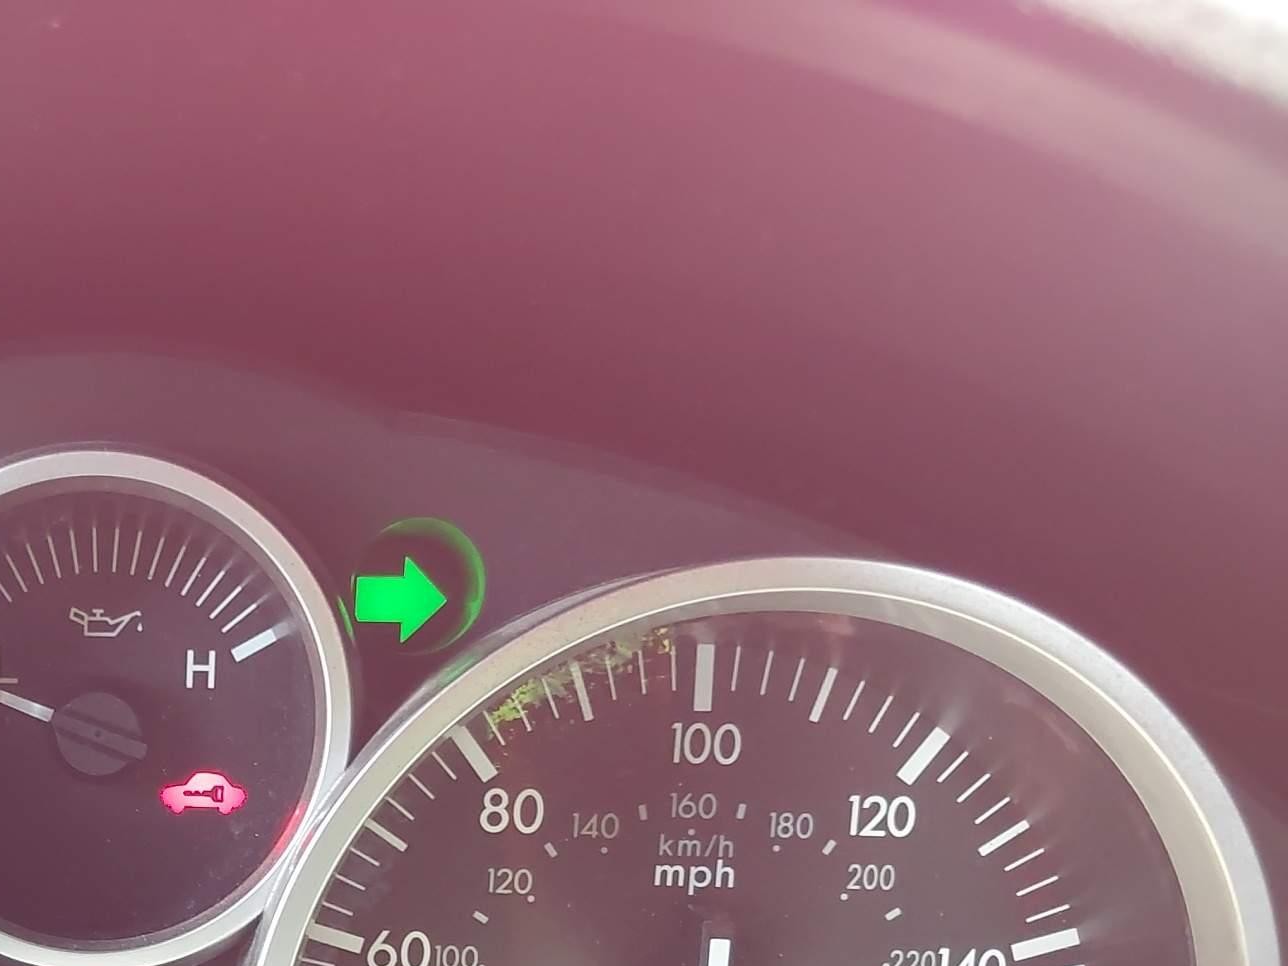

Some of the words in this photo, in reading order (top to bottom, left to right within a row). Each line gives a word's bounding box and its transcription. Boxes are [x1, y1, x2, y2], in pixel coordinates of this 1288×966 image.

[186, 649, 216, 689] H
[671, 722, 742, 766] 100
[479, 787, 545, 835] 80
[670, 793, 717, 820] 160
[848, 795, 916, 838] 120
[572, 813, 620, 839] 140
[769, 812, 813, 840] 180
[657, 834, 735, 859] km/h
[487, 867, 533, 895] 120
[653, 860, 735, 896] mph
[846, 864, 895, 891] 200
